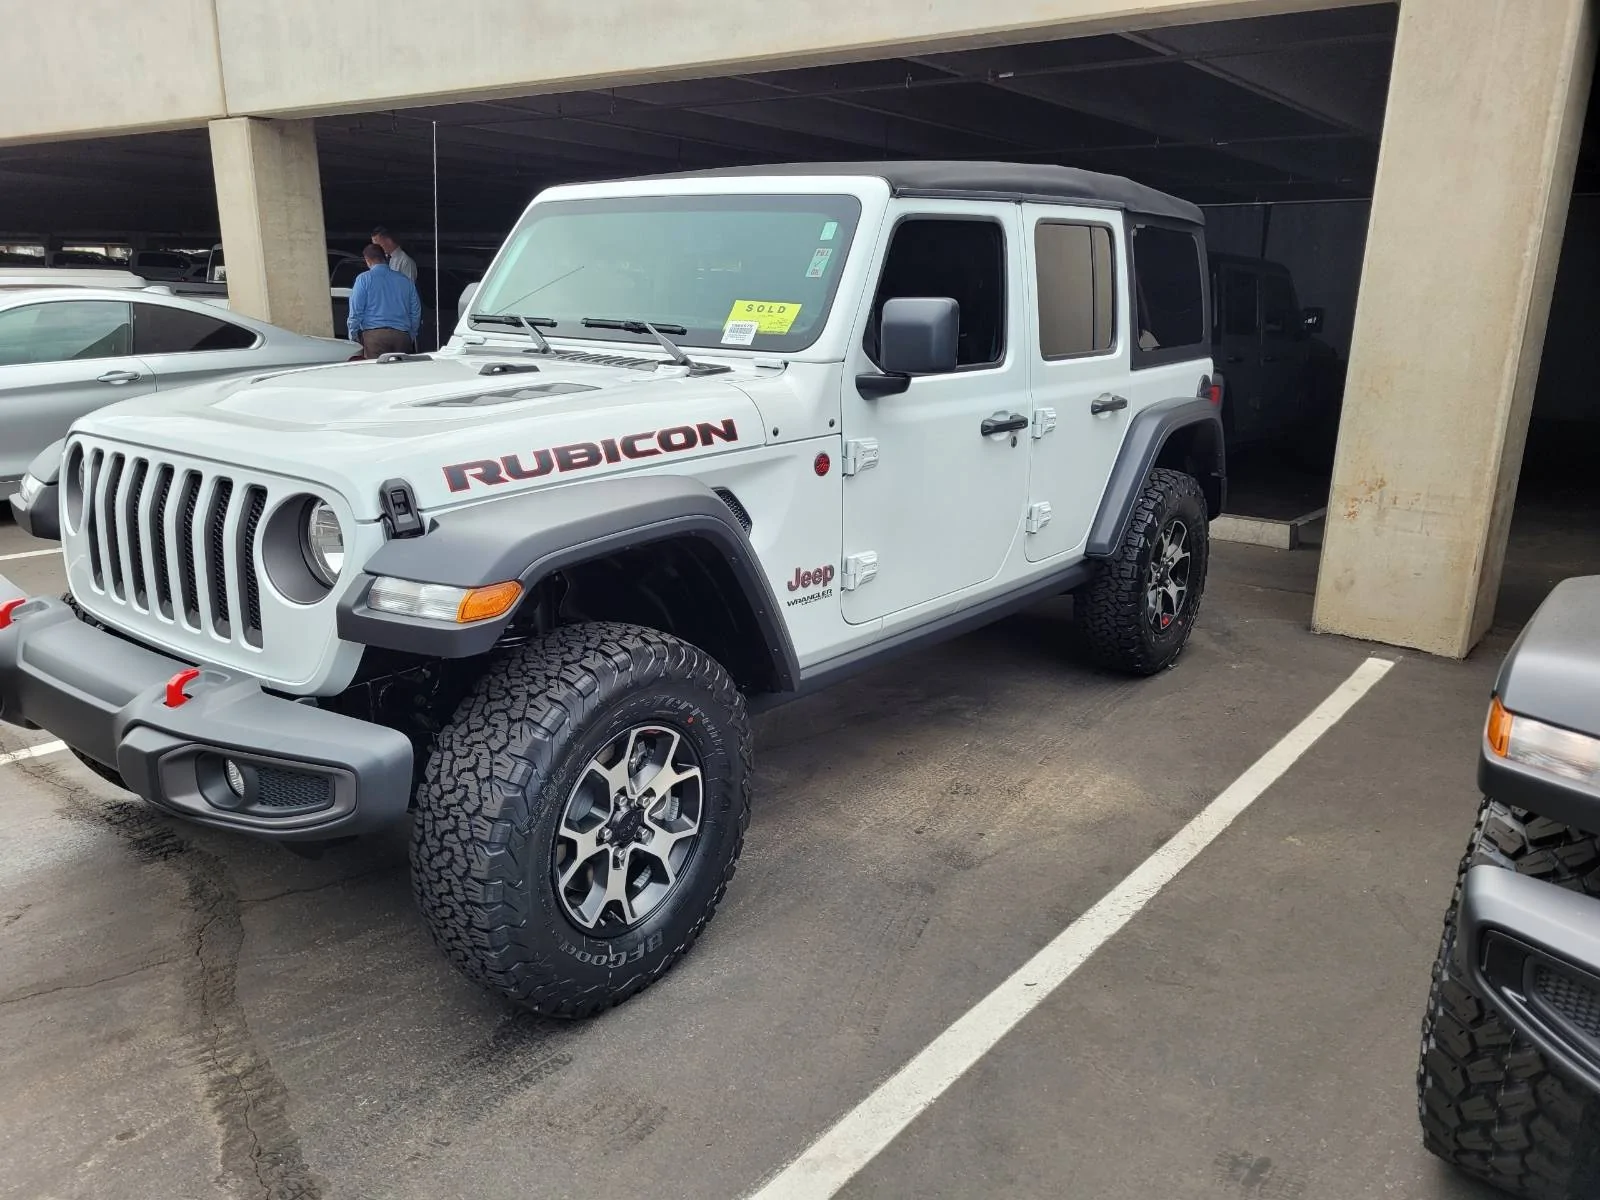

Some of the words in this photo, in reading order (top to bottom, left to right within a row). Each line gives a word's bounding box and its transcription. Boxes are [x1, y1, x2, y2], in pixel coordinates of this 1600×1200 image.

[745, 304, 786, 314] SOLD
[442, 418, 739, 493] RUBICON
[787, 564, 835, 592] Jeep
[786, 588, 833, 607] WRANGLER
